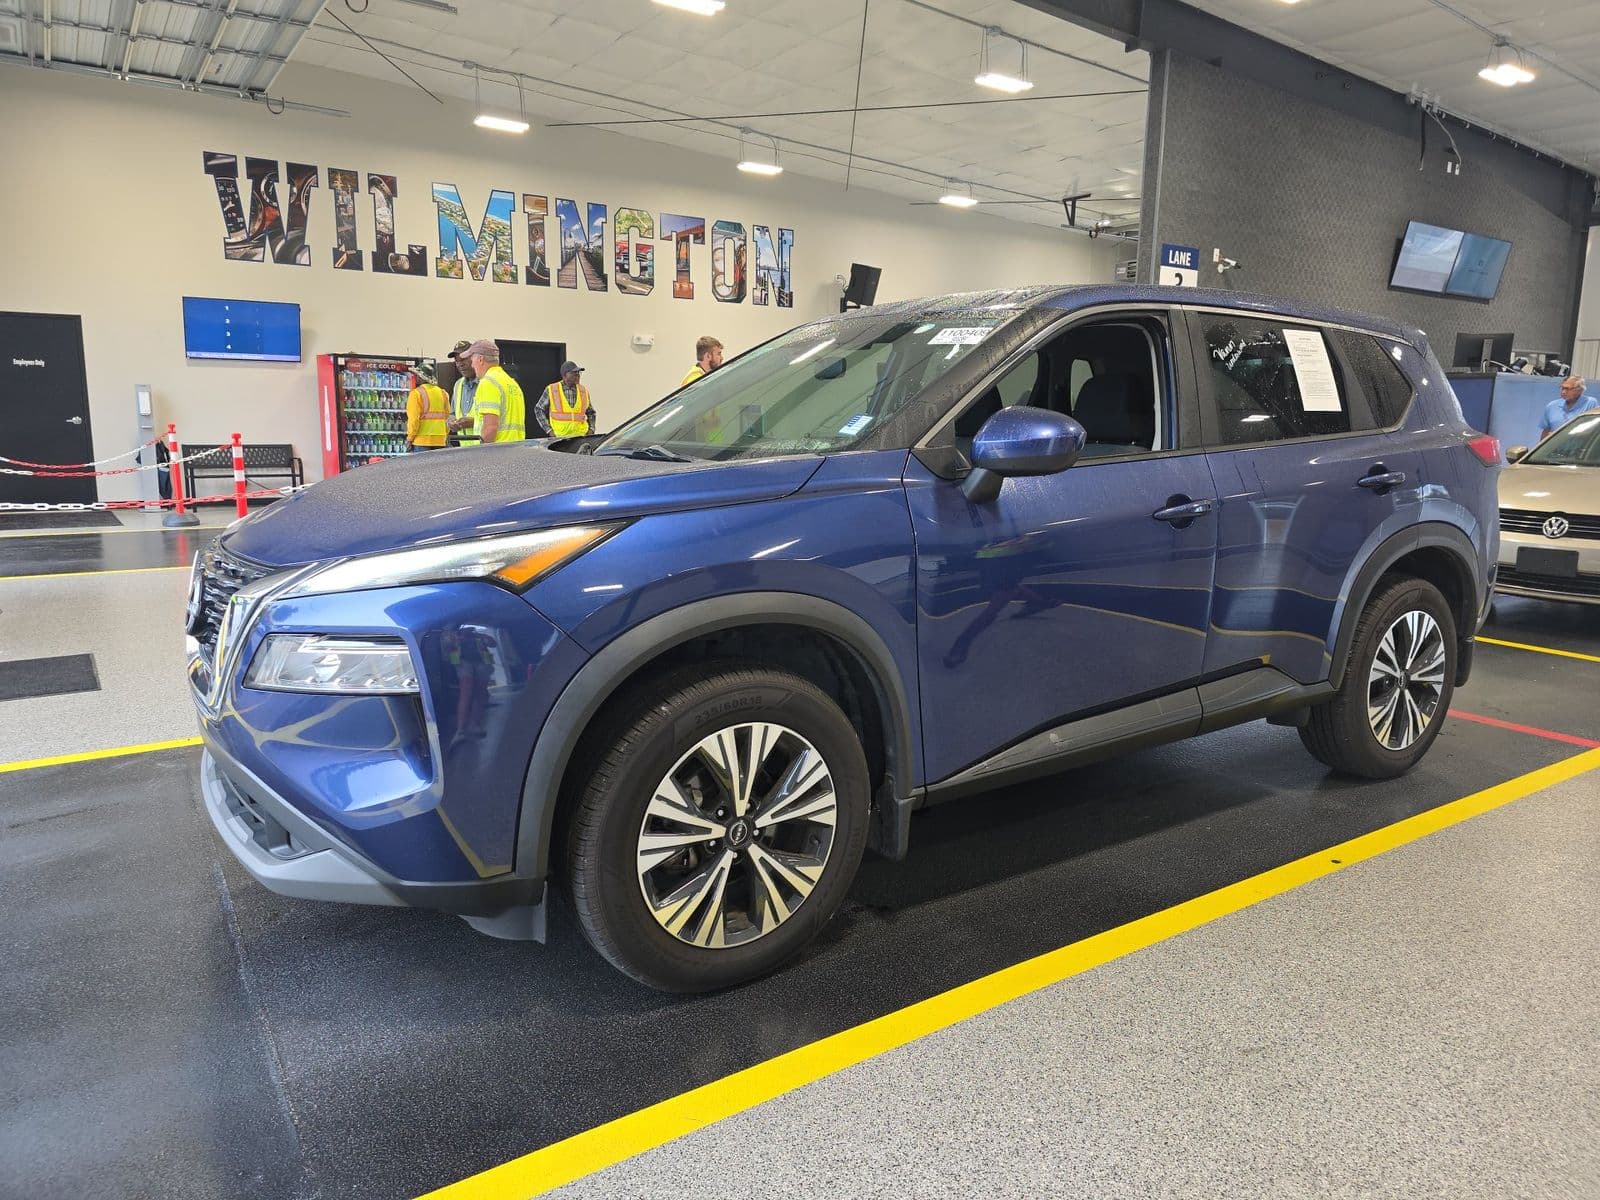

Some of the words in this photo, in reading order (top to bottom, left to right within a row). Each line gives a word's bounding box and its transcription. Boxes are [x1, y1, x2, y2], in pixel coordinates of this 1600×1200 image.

[203, 151, 794, 308] WILMINGTON
[1168, 249, 1192, 267] LANE
[12, 358, 34, 367] Employees
[378, 362, 396, 370] COLD
